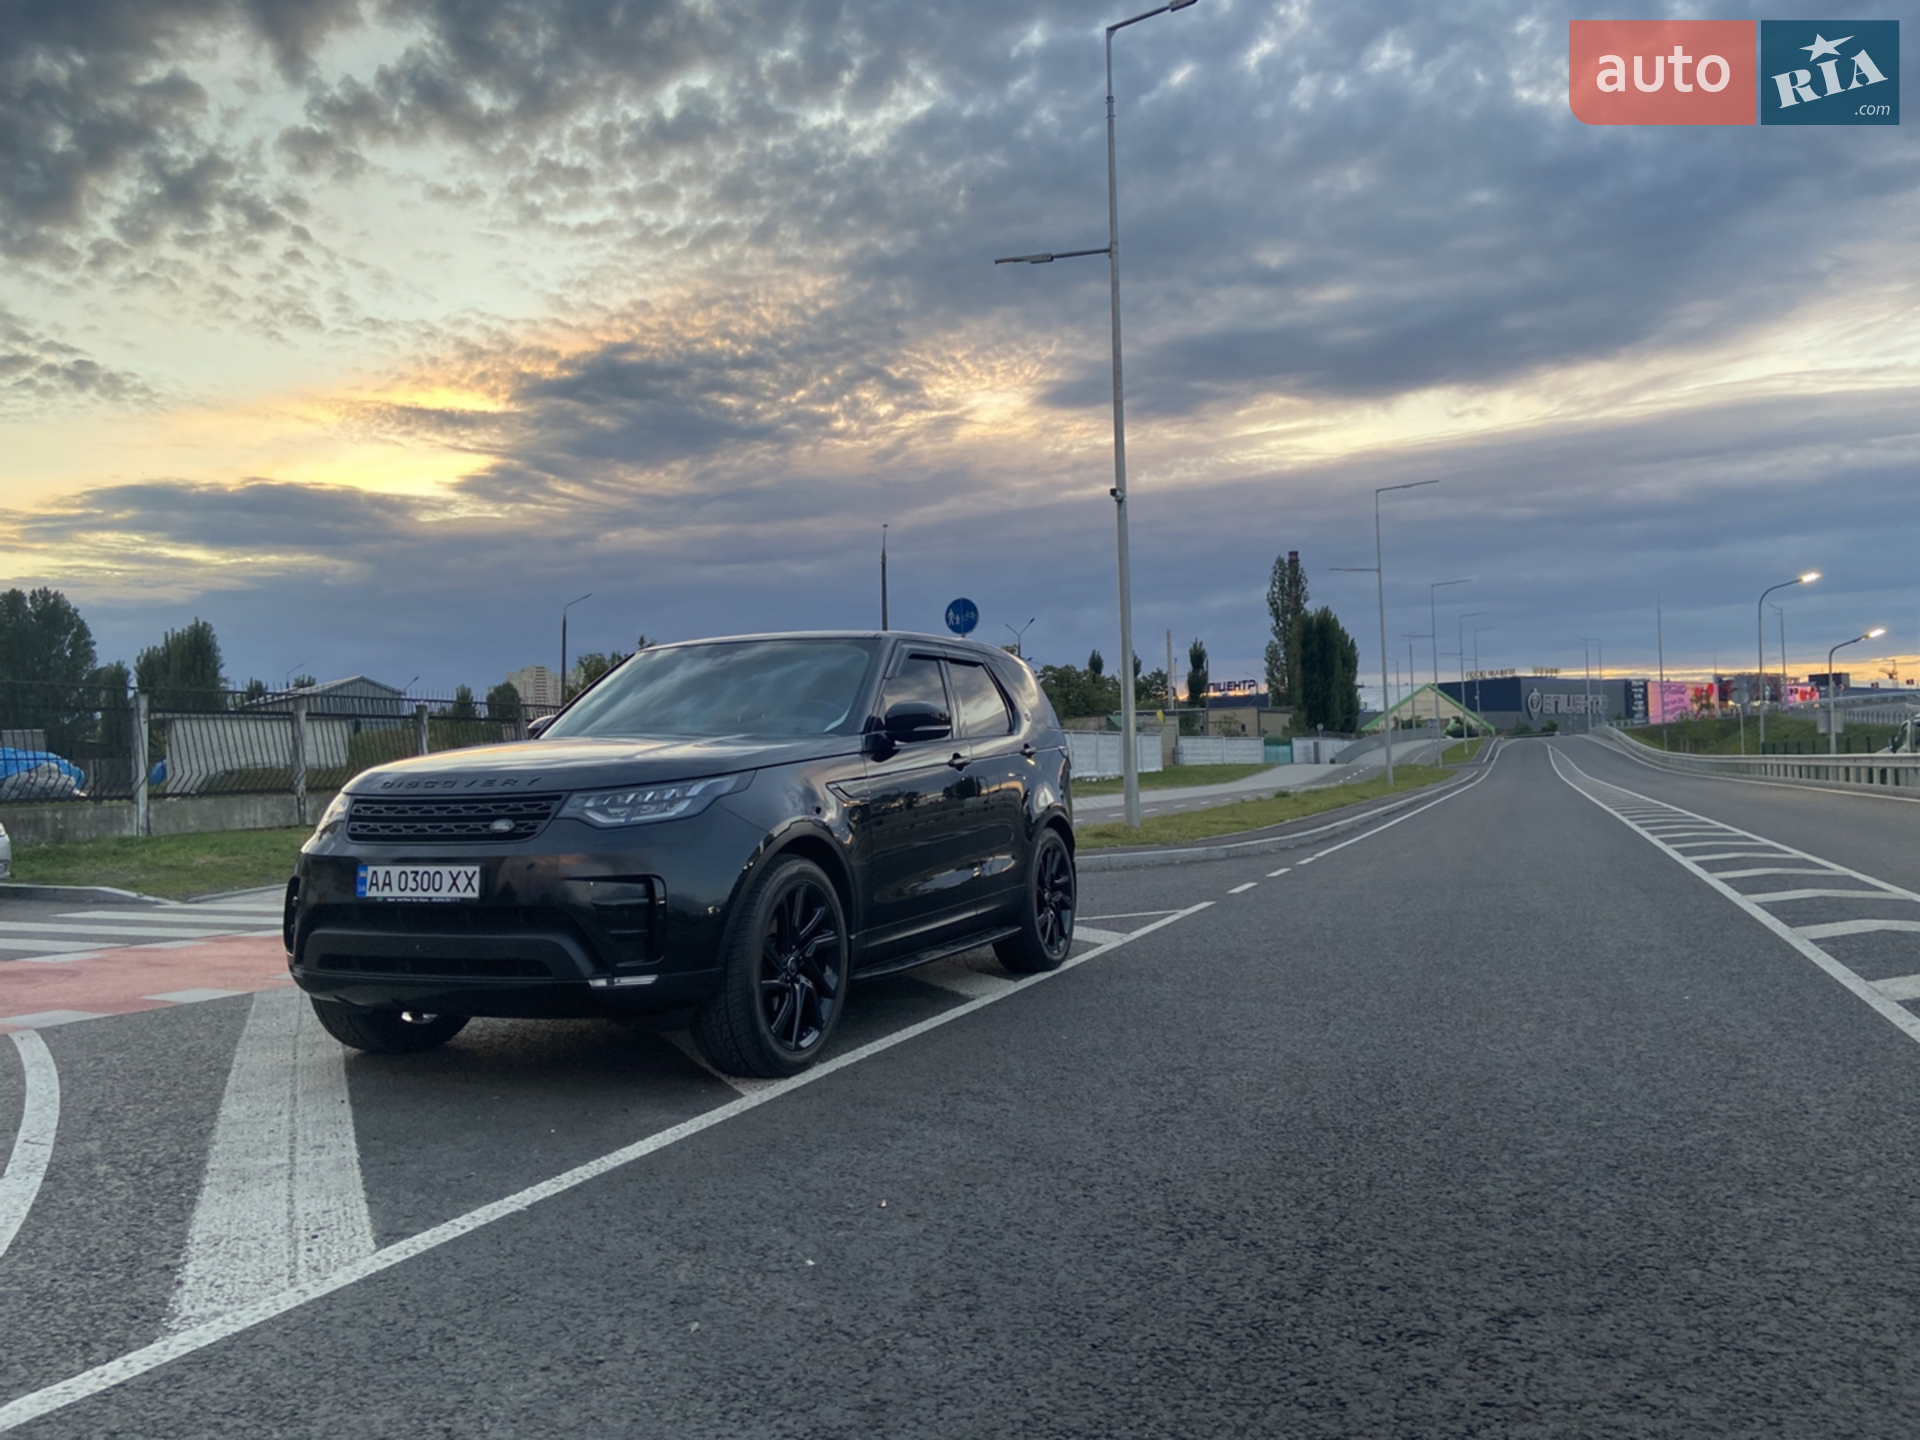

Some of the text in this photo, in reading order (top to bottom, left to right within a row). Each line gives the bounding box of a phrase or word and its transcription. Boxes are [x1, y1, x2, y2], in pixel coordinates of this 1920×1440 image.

[381, 777, 541, 789] DISCOVERY
[368, 870, 478, 893] AA 0300 XX
